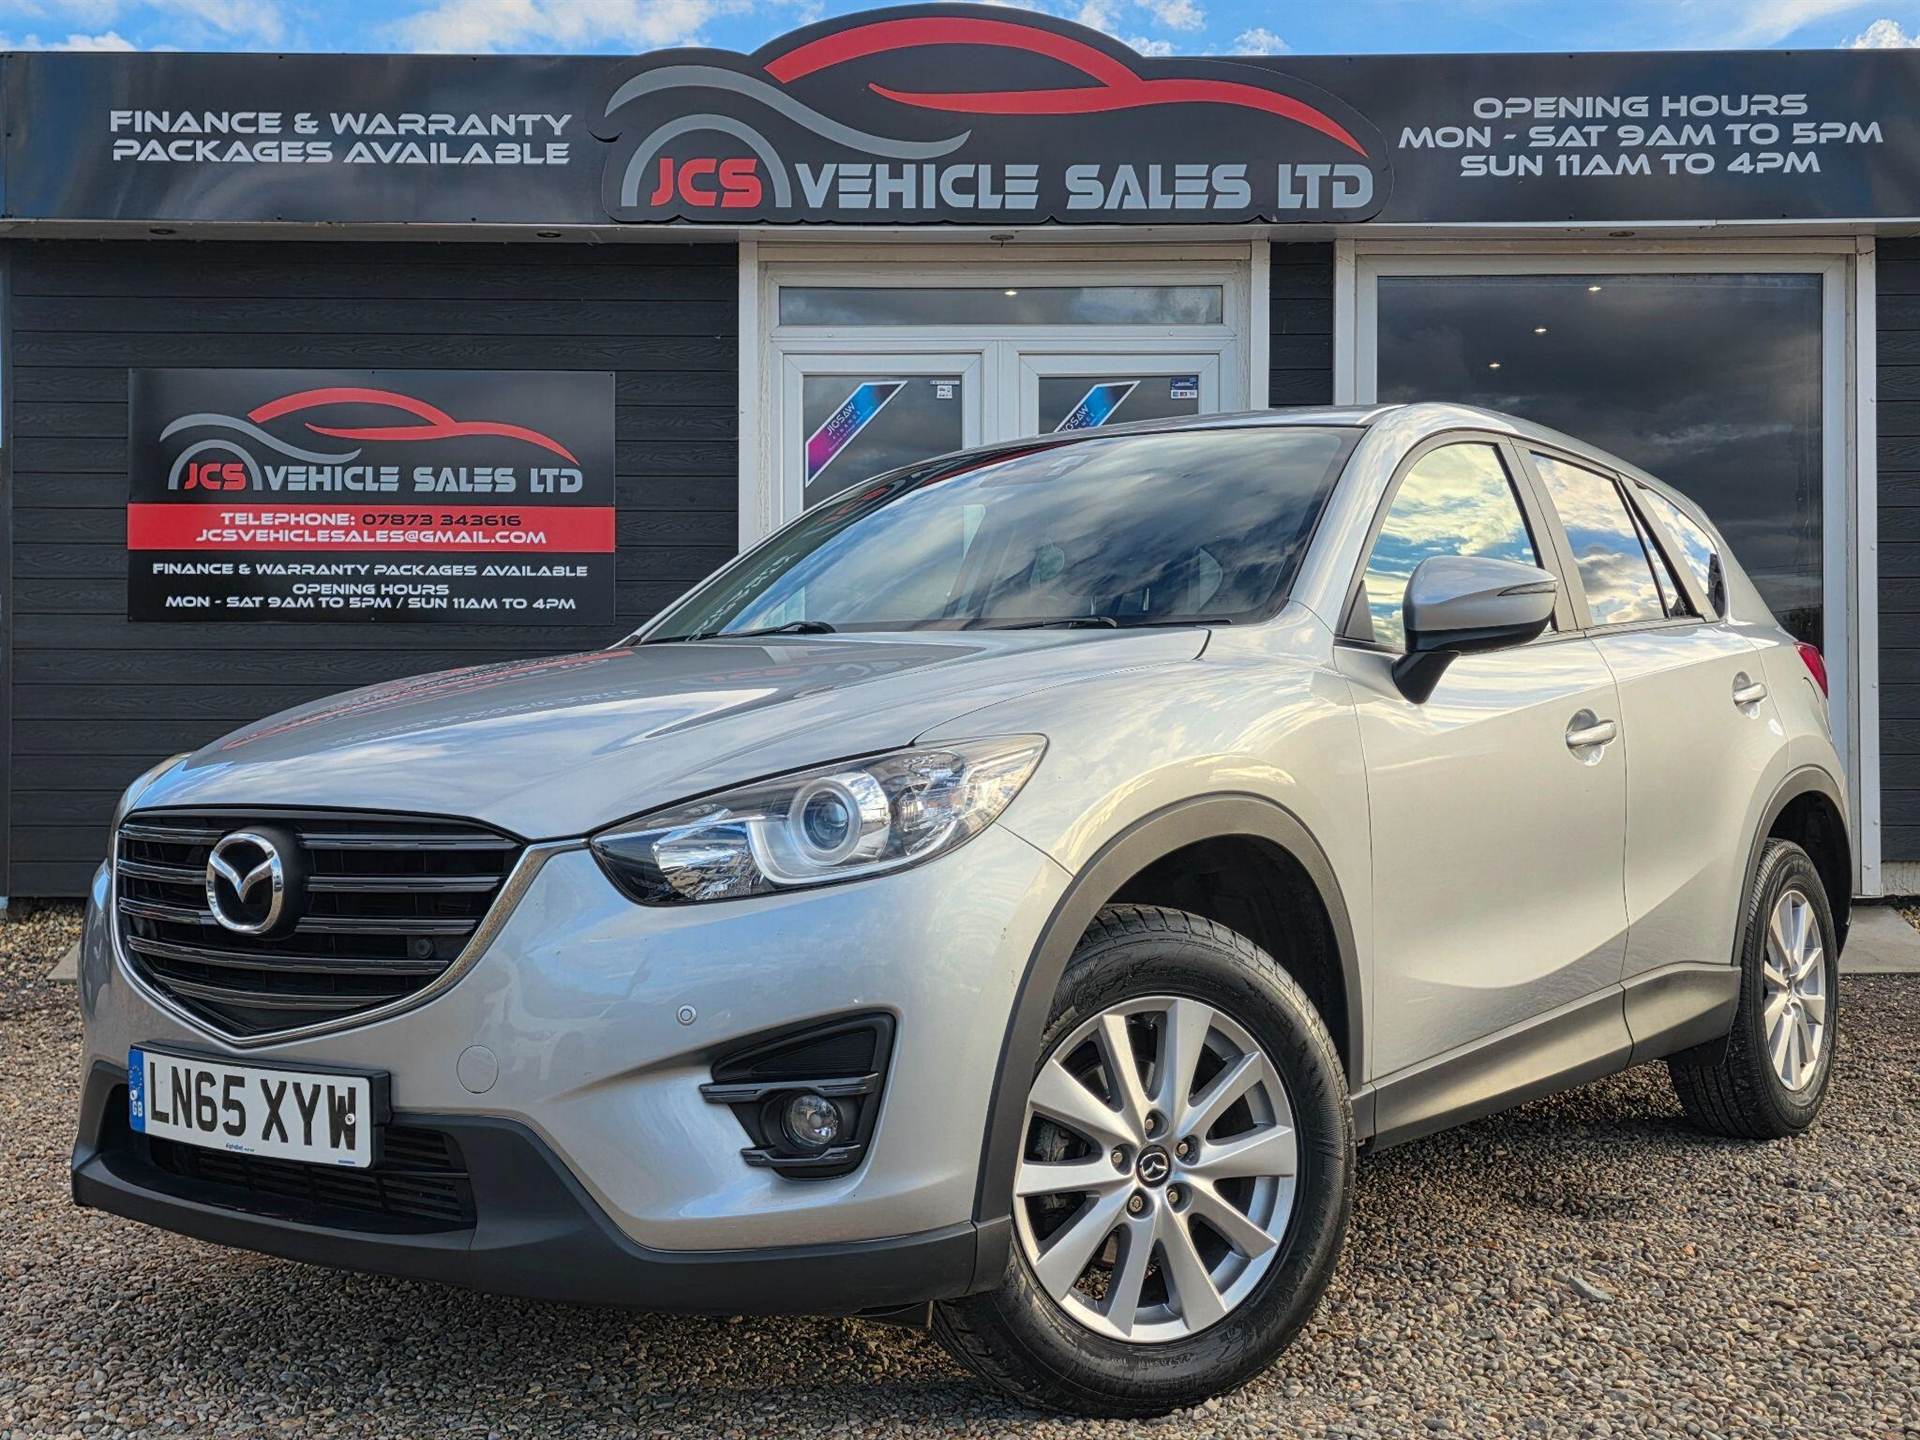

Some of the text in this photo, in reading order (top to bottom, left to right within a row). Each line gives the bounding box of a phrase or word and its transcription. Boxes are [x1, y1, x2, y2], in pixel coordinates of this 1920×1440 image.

[1473, 94, 1808, 119] OPENING HOURS
[110, 110, 573, 136] FINANCE & WARRANTY
[1398, 126, 1492, 149] MON
[1528, 124, 1609, 147] SAT
[1617, 124, 1716, 147] 9AM
[1725, 123, 1779, 145] TO
[1792, 122, 1884, 144] 5PM
[113, 139, 570, 164] PACKAGES AVAILABLE
[1459, 151, 1821, 177] SUN 11AM TO 4PM
[650, 158, 1374, 210] JCS VEHICLE SALES LTD
[826, 401, 855, 436] JIGSAW
[833, 410, 861, 440] FINANCE
[1059, 404, 1089, 433] GSAW
[184, 463, 583, 493] JCS VEHICLE SALES LTD
[220, 513, 522, 527] TELEPHONE: 07873 343616
[195, 529, 546, 544] JCSVEHICLESALES@GMAIL.COM
[153, 563, 588, 577] FINANCE & WARRANTY PACKAGES AVAILABLE
[292, 583, 450, 595] OPENING HOURS
[165, 596, 210, 607] MON
[226, 597, 265, 608] SAT
[267, 597, 316, 608] 9AM
[318, 597, 344, 608] TO
[349, 598, 393, 609] 5PM
[408, 598, 448, 609] SUN
[452, 598, 499, 610] 11AM
[501, 598, 528, 610] TO
[532, 598, 576, 610] 4PM
[132, 1100, 143, 1117] GB
[150, 1062, 356, 1150] LN65 XYW
